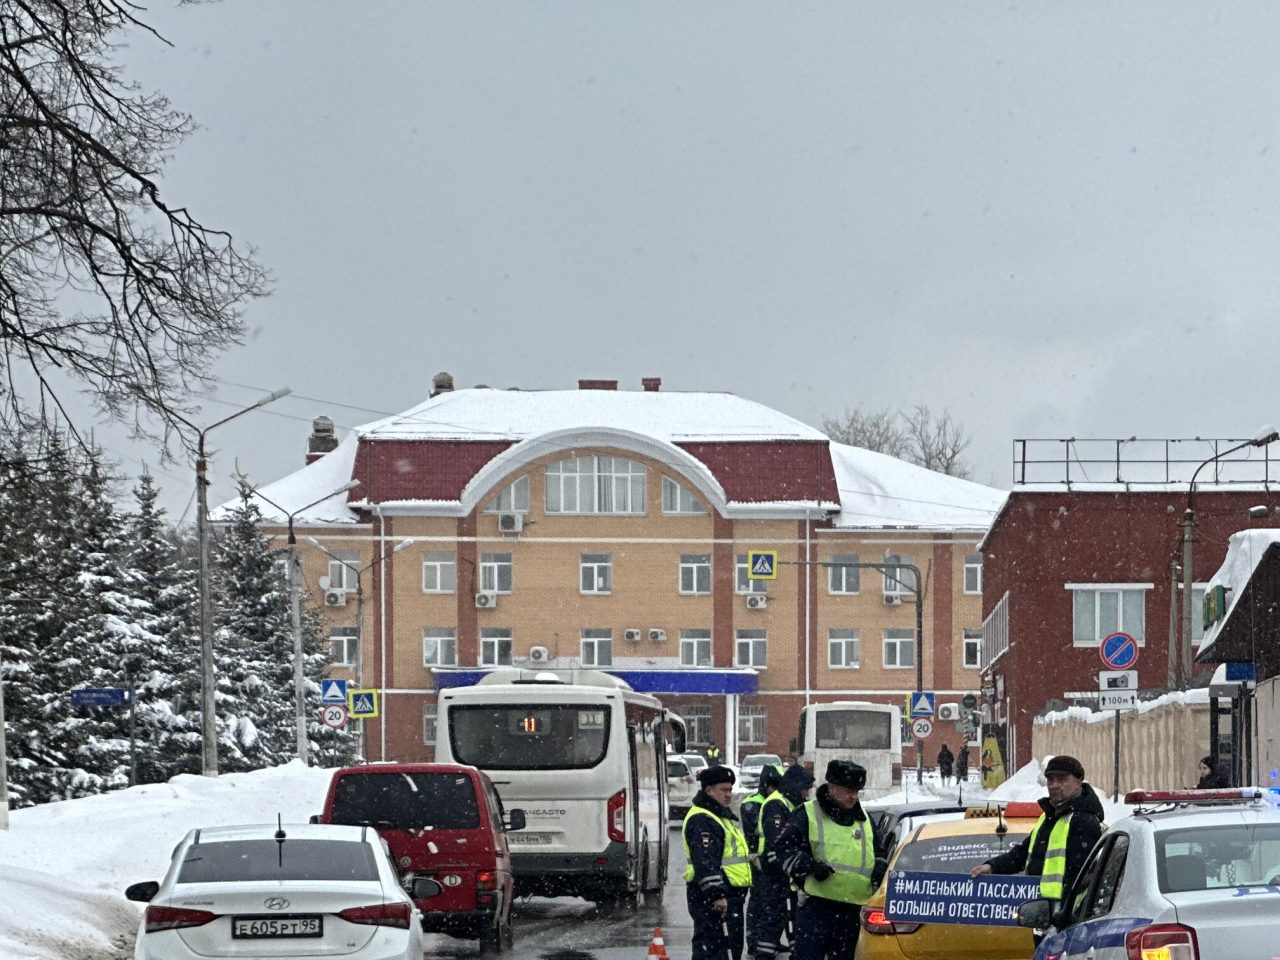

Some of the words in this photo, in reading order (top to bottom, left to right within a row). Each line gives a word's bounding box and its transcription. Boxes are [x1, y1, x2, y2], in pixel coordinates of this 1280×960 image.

[1109, 696, 1128, 705] 100м
[328, 710, 341, 720] 20
[524, 717, 535, 732] 11
[916, 722, 929, 733] 20
[938, 843, 988, 852] Яндекс
[894, 878, 974, 898] #МАЛЕНЬКИЙ
[889, 900, 944, 917] БОЛЬШАЯ
[948, 902, 1019, 920] ОТВЕТСТВЕН
[239, 921, 298, 936] Е605РТ
[302, 920, 317, 931] 95
